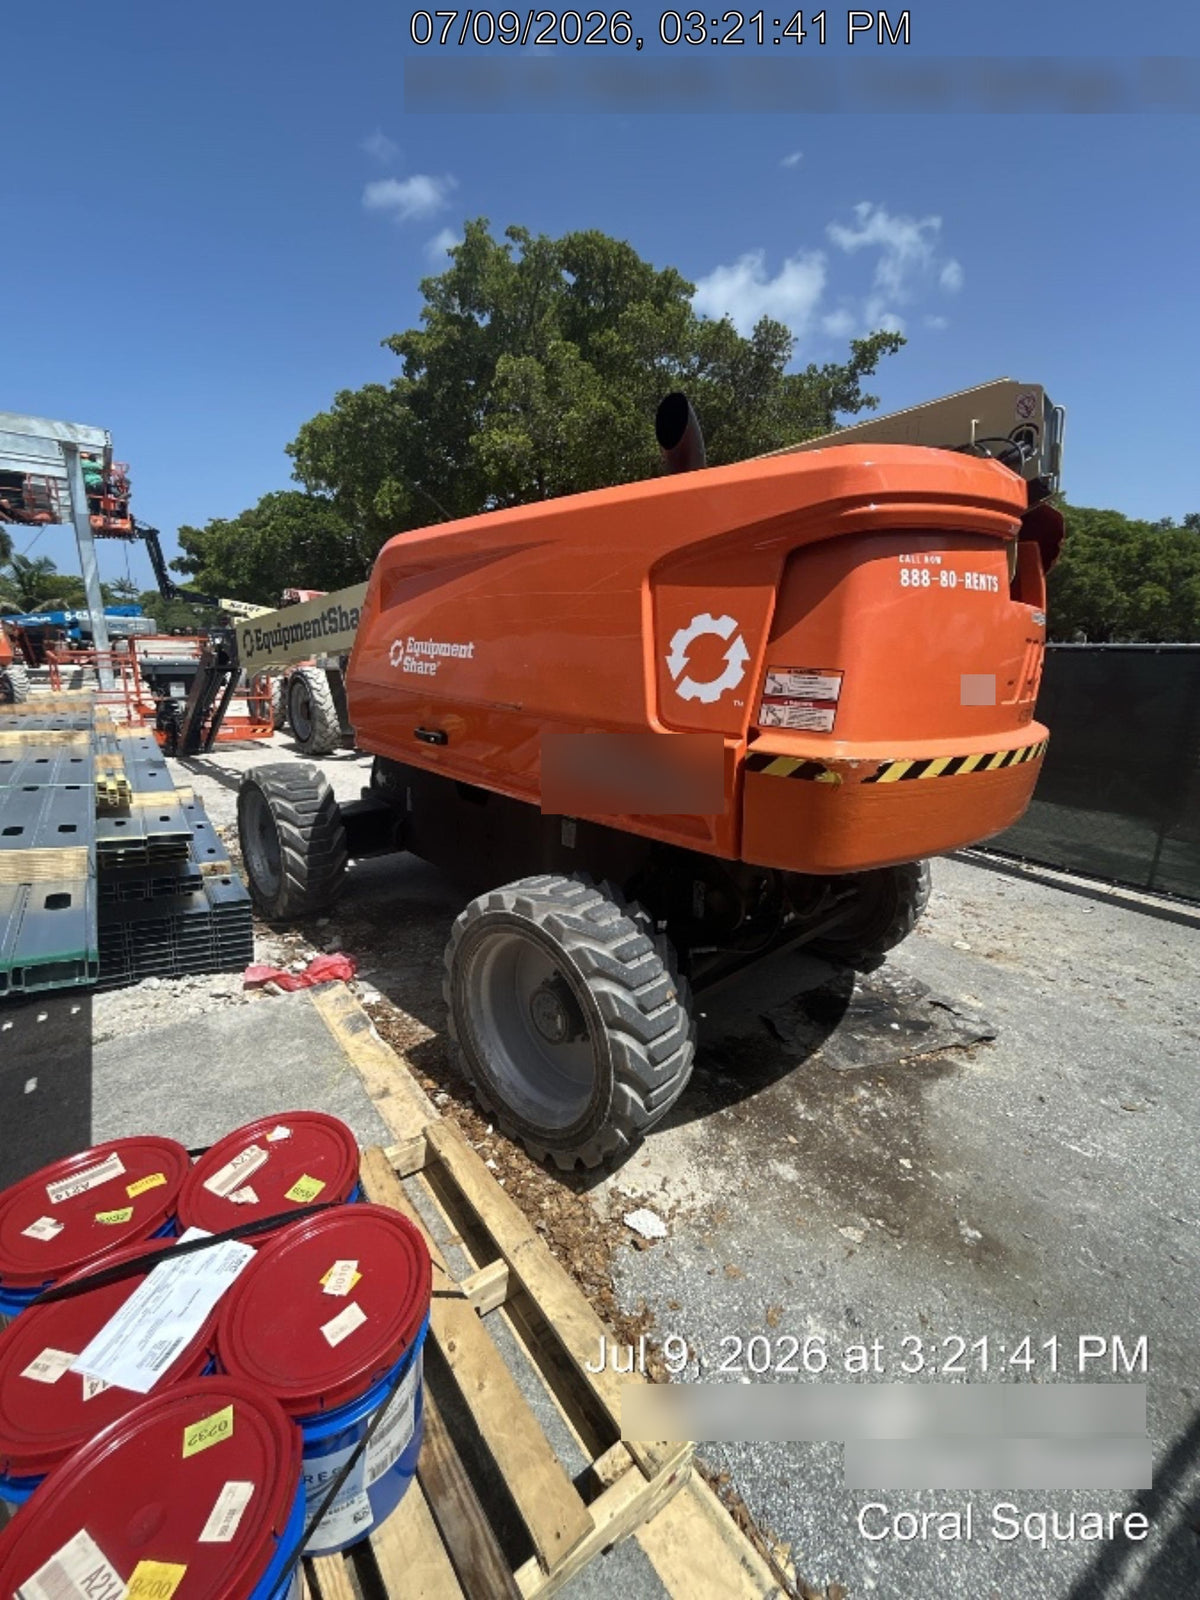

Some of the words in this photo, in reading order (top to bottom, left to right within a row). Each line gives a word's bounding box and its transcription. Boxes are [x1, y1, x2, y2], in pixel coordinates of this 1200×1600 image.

[899, 554, 921, 565] CALL
[923, 555, 942, 565] NOW
[900, 568, 999, 592] 888-80-RENTS
[255, 603, 362, 655] EquipmentSha
[406, 636, 474, 659] Equipment
[402, 655, 437, 676] Share
